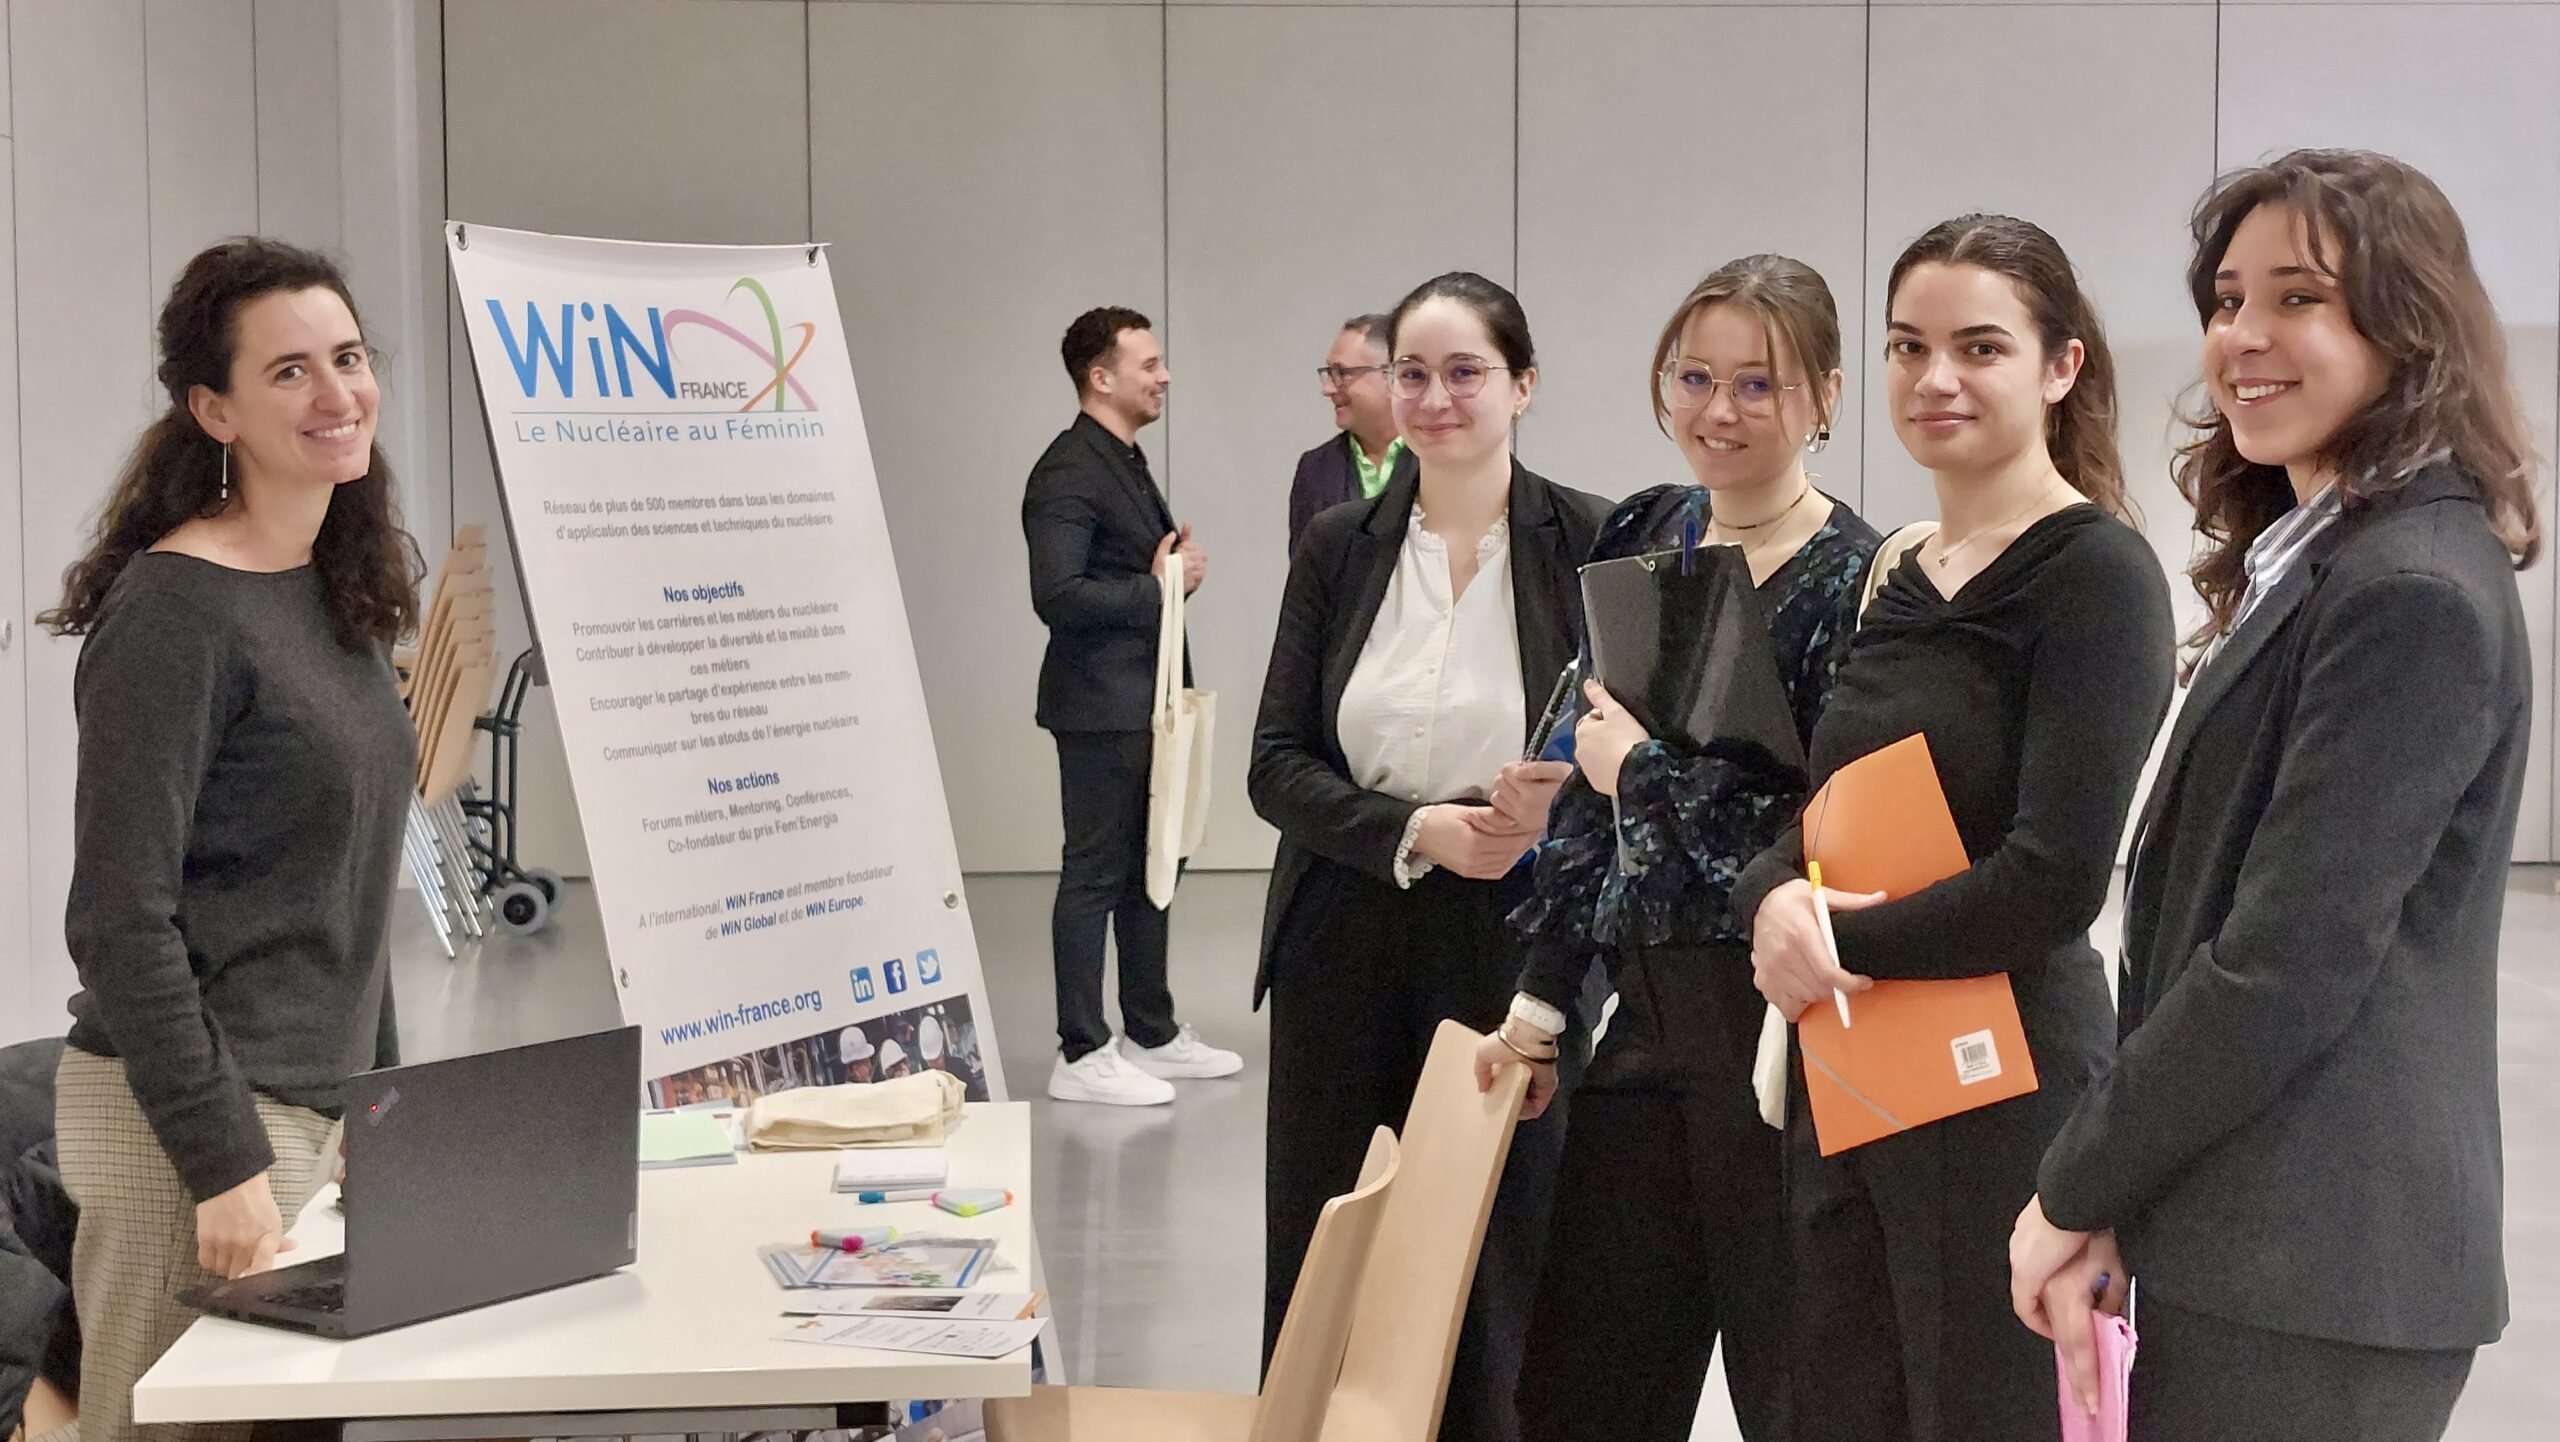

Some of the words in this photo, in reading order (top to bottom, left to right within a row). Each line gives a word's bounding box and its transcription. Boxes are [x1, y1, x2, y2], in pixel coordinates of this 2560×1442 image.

[485, 300, 677, 399] WiN
[681, 382, 748, 400] FRANCE
[516, 419, 545, 444] Le
[557, 418, 679, 443] Nucléaire
[689, 423, 718, 441] au
[727, 418, 824, 440] Féminin
[544, 500, 586, 515] Réseau
[589, 499, 602, 513] de
[606, 498, 628, 516] plus
[631, 498, 644, 512] de
[647, 497, 665, 511] 500
[668, 495, 716, 510] membres
[719, 494, 743, 508] dans
[746, 493, 768, 506] tous
[770, 492, 784, 504] les
[788, 490, 834, 504] domaines
[556, 525, 628, 542] d'application
[631, 523, 650, 537] des
[652, 521, 699, 535] sciences
[702, 520, 712, 533] et
[713, 517, 770, 532] techniques
[772, 516, 784, 528] du
[787, 513, 833, 527] nucléaire
[664, 586, 689, 602] Nos
[692, 582, 744, 603] objectifs
[573, 618, 636, 637] Promouvoir
[639, 617, 654, 632] les
[657, 614, 705, 630] carrières
[707, 612, 718, 626] et
[720, 611, 735, 624] les
[737, 607, 775, 622] métiers
[778, 604, 790, 618] du
[793, 600, 838, 617] nucléaire
[576, 644, 633, 662] Contribuer
[638, 642, 644, 656] à
[647, 638, 705, 656] développer
[708, 634, 717, 649] la
[720, 630, 763, 647] diversité
[766, 629, 776, 643] et
[778, 627, 788, 641] la
[790, 625, 819, 640] mixité
[822, 623, 845, 637] dans
[690, 663, 709, 675] ces
[711, 657, 749, 673] métiers
[590, 693, 652, 712] Encourager
[655, 690, 665, 704] le
[668, 686, 709, 706] partage
[711, 678, 777, 699] d'expérience
[780, 675, 806, 688] entre
[808, 672, 823, 686] les
[825, 670, 852, 683] mem-
[691, 710, 715, 725] bres
[718, 708, 730, 721] du
[733, 703, 768, 719] réseau
[604, 739, 677, 761] Communiquer
[681, 738, 697, 751] sur
[700, 735, 715, 749] les
[718, 729, 750, 746] atouts
[752, 727, 765, 741] de
[766, 721, 811, 739] l'énergie
[813, 714, 859, 732] nucléaire
[708, 778, 733, 795] Nos
[736, 771, 780, 790] actions
[642, 816, 682, 833] Forums
[685, 808, 728, 825] métiers,
[729, 799, 784, 818] Mentoring,
[786, 787, 853, 808] Conférences,
[668, 829, 735, 853] Co-fondateur
[739, 827, 751, 841] du
[754, 823, 773, 842] prix
[726, 893, 746, 911] WiN
[749, 888, 784, 905] France
[787, 883, 802, 899] est
[804, 876, 844, 894] membre
[847, 864, 894, 885] fondateur
[705, 925, 718, 941] de
[721, 920, 741, 937] WiN
[744, 912, 776, 932] Global
[779, 910, 789, 924] et
[791, 909, 803, 923] de
[806, 901, 825, 918] WiN
[661, 990, 822, 1045] www.win-france.org
